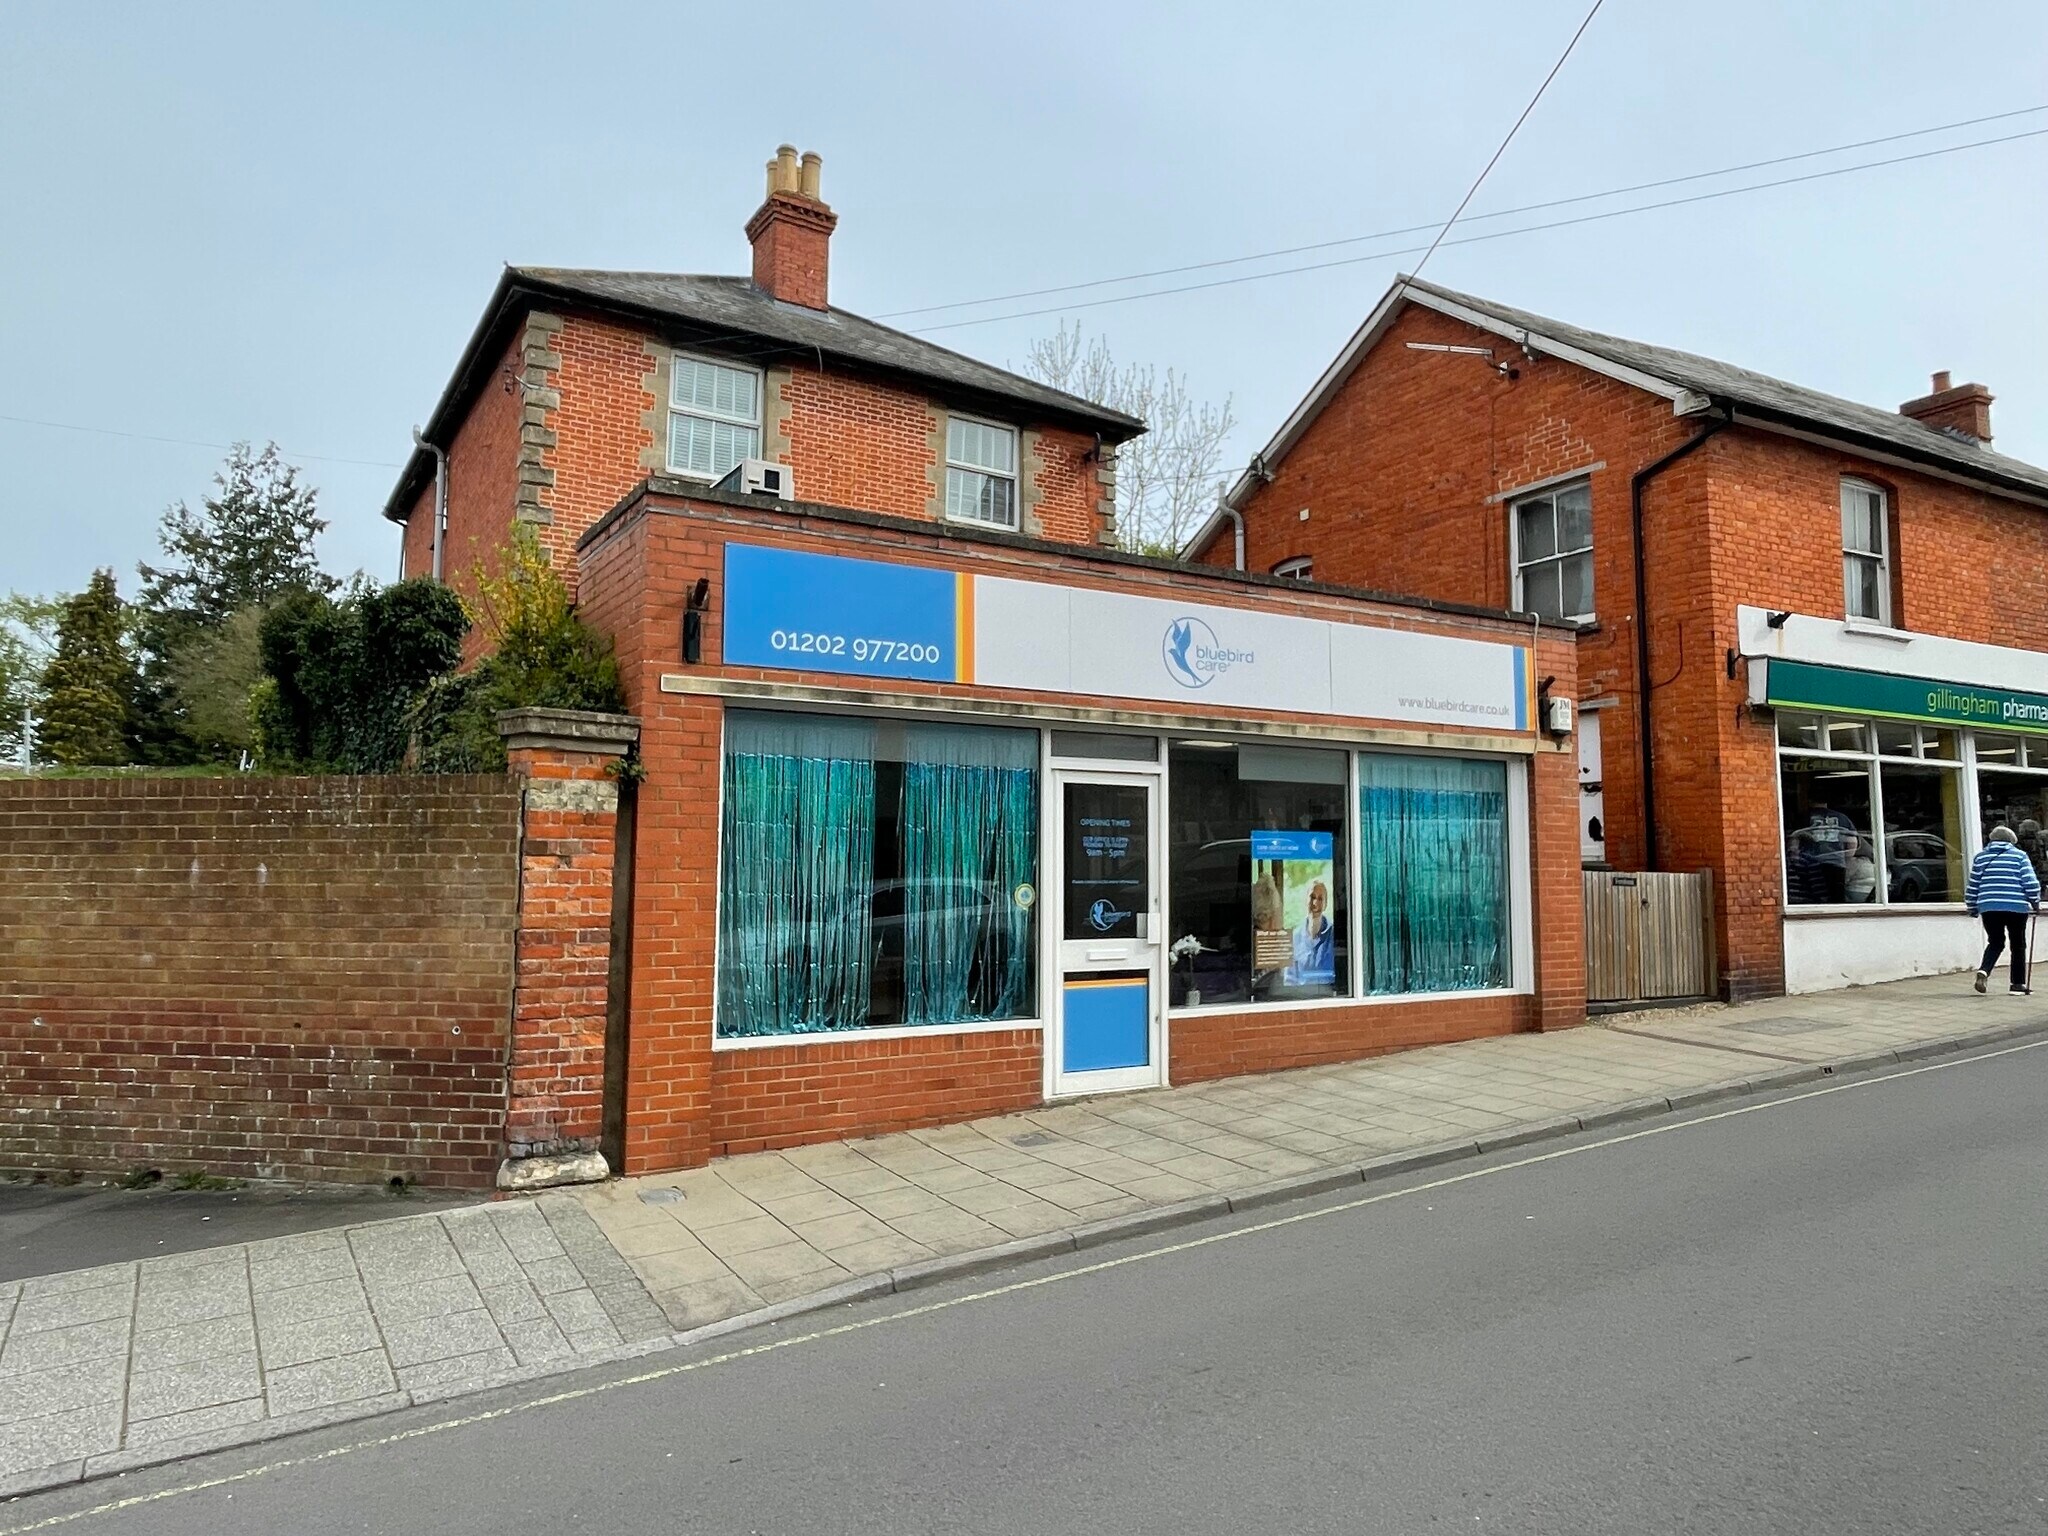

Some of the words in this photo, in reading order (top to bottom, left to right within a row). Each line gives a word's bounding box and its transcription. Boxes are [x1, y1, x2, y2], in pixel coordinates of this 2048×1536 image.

[771, 630, 845, 655] 01202
[853, 638, 939, 664] 977200
[1196, 645, 1254, 664] bluebird
[1196, 660, 1226, 672] care
[1398, 696, 1510, 717] www.bluebirdcare.co.uk
[1927, 688, 1999, 716] gillingham
[2003, 698, 2048, 720] pharma
